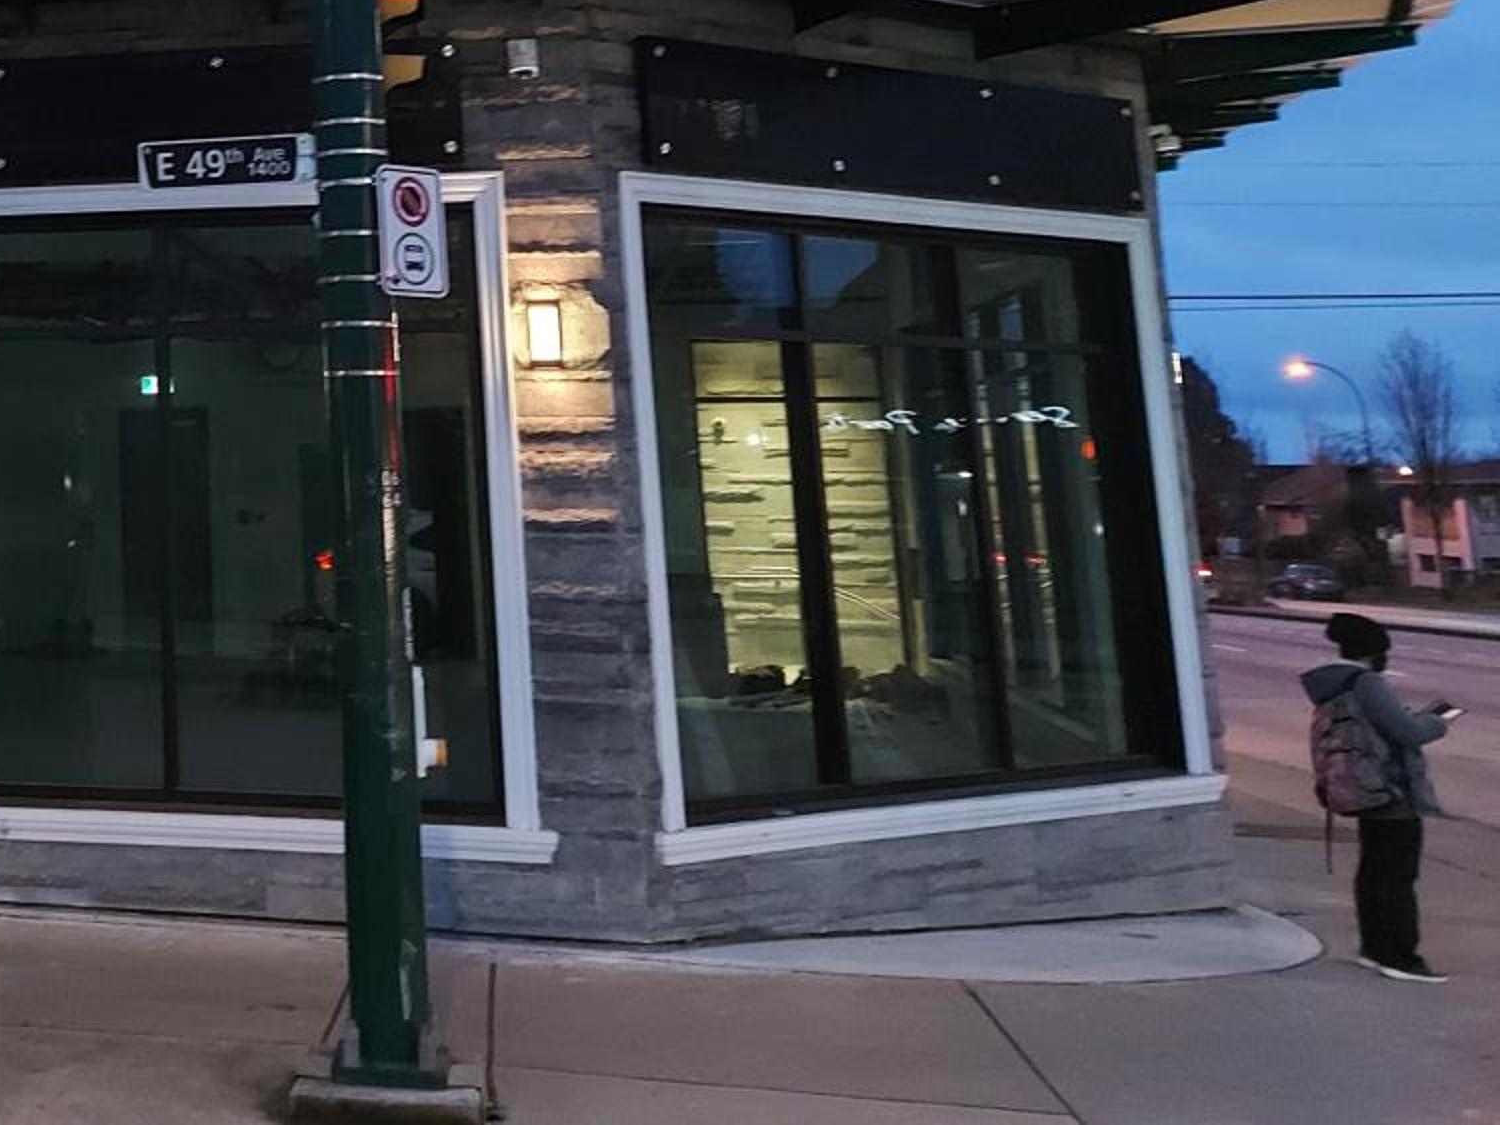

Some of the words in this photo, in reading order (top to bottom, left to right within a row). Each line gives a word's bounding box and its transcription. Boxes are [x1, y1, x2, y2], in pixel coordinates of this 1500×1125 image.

[155, 152, 177, 181] E
[185, 147, 245, 179] 49th
[252, 146, 286, 162] Ave
[247, 160, 292, 177] 1400
